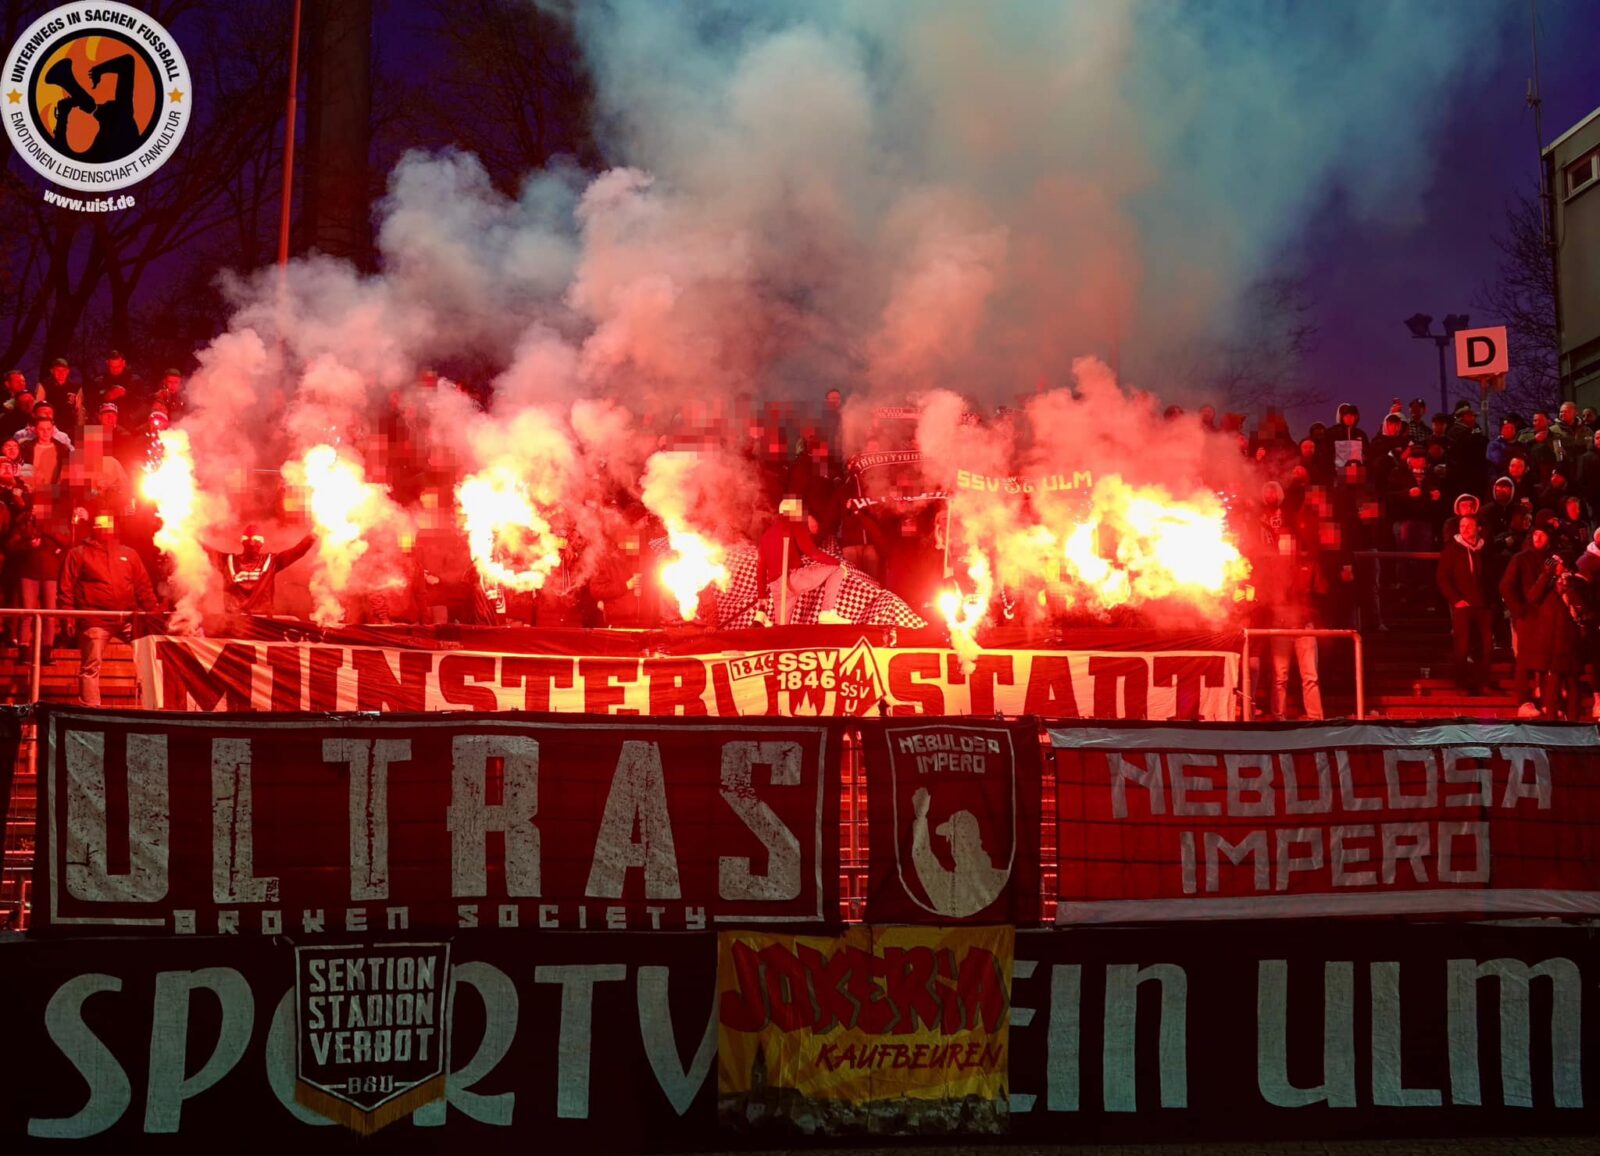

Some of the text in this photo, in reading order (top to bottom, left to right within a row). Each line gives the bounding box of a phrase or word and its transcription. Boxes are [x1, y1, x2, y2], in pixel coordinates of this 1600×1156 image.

[1466, 336, 1496, 368] D
[777, 651, 838, 672] SSV
[776, 670, 836, 690] 1846
[888, 652, 1225, 720] STADT
[899, 733, 1000, 754] NEBULOSA
[916, 752, 986, 774] IMPERO
[1106, 746, 1552, 819] NEBULOSA
[65, 730, 803, 904] ULTRAS
[1180, 821, 1490, 894] IMPERO
[173, 904, 706, 935] BROKEN SOCIETY
[309, 956, 437, 993] SEKTION
[308, 992, 435, 1030] STADION
[308, 1028, 434, 1066] VERBOT
[815, 1042, 1003, 1072] KAUFBEUREN
